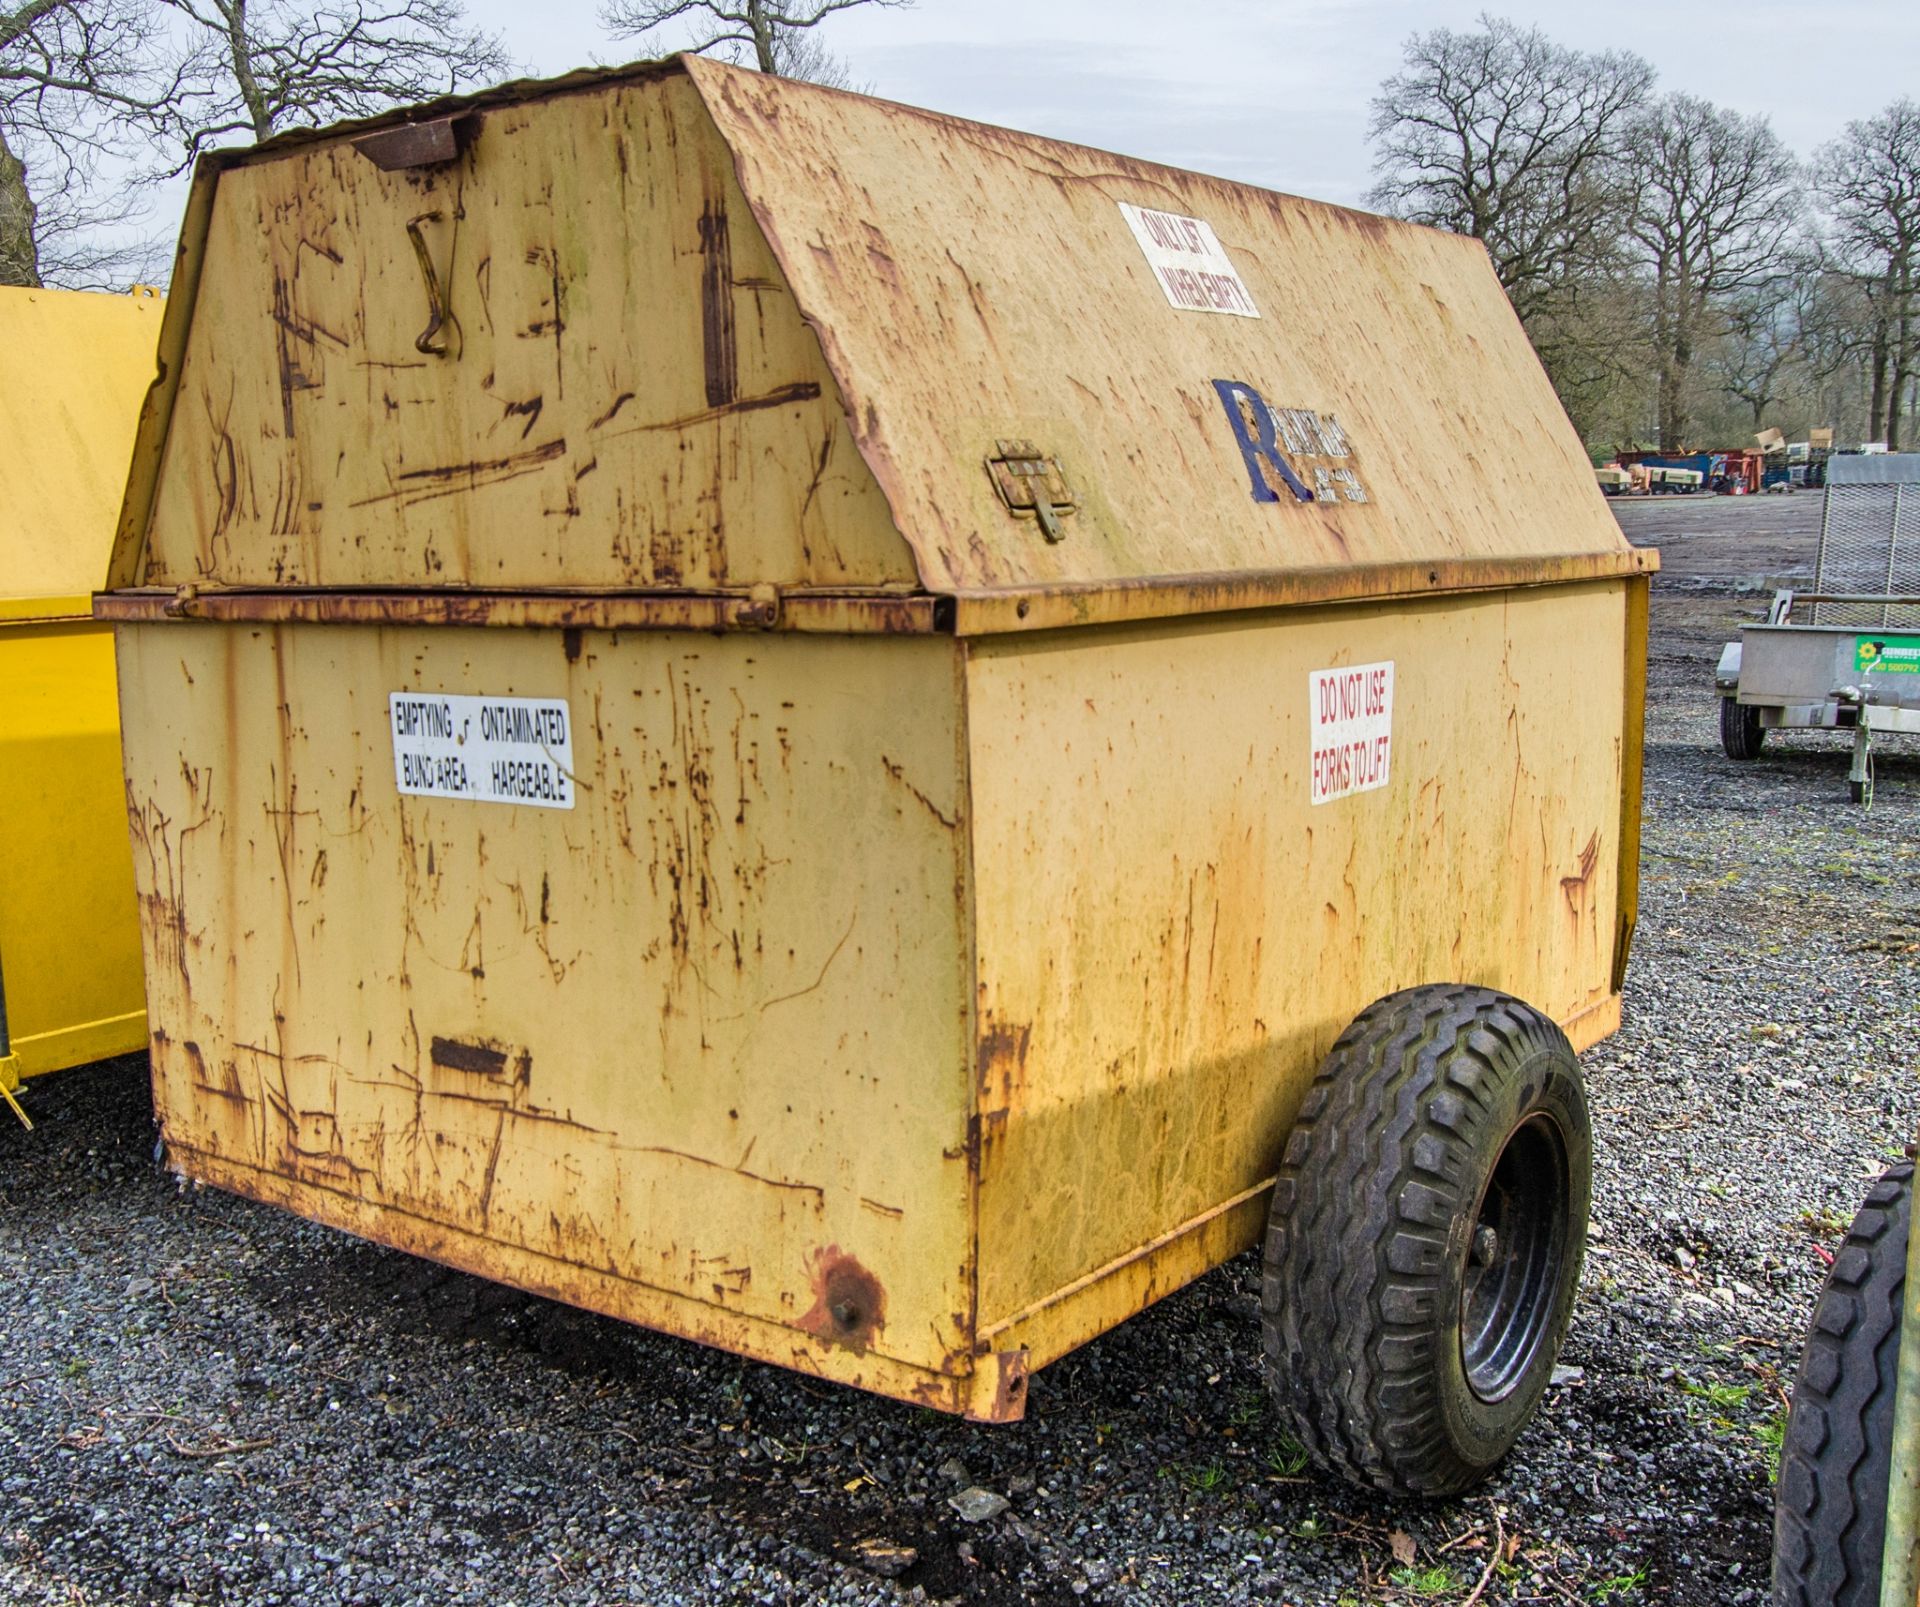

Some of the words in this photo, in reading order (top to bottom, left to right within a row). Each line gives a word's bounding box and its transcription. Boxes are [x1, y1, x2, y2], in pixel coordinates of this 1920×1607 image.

[1140, 210, 1185, 251] ONLY
[1173, 217, 1211, 256] LIFT
[1158, 265, 1212, 308] WHEN
[1198, 271, 1251, 312] EMPTY
[1882, 647, 1920, 657] SUNBEL
[1319, 677, 1337, 725] DO
[1340, 673, 1363, 721] NOT
[1365, 669, 1386, 717] USE
[395, 701, 452, 738] EMPTYING
[480, 705, 565, 745] ONTAMINATED
[402, 753, 434, 789] BUND
[437, 757, 468, 791] AREA
[491, 760, 566, 801] HARGEABLE
[1313, 744, 1351, 797] FORKS
[1353, 740, 1367, 786] TO
[1368, 736, 1389, 783] LIFT
